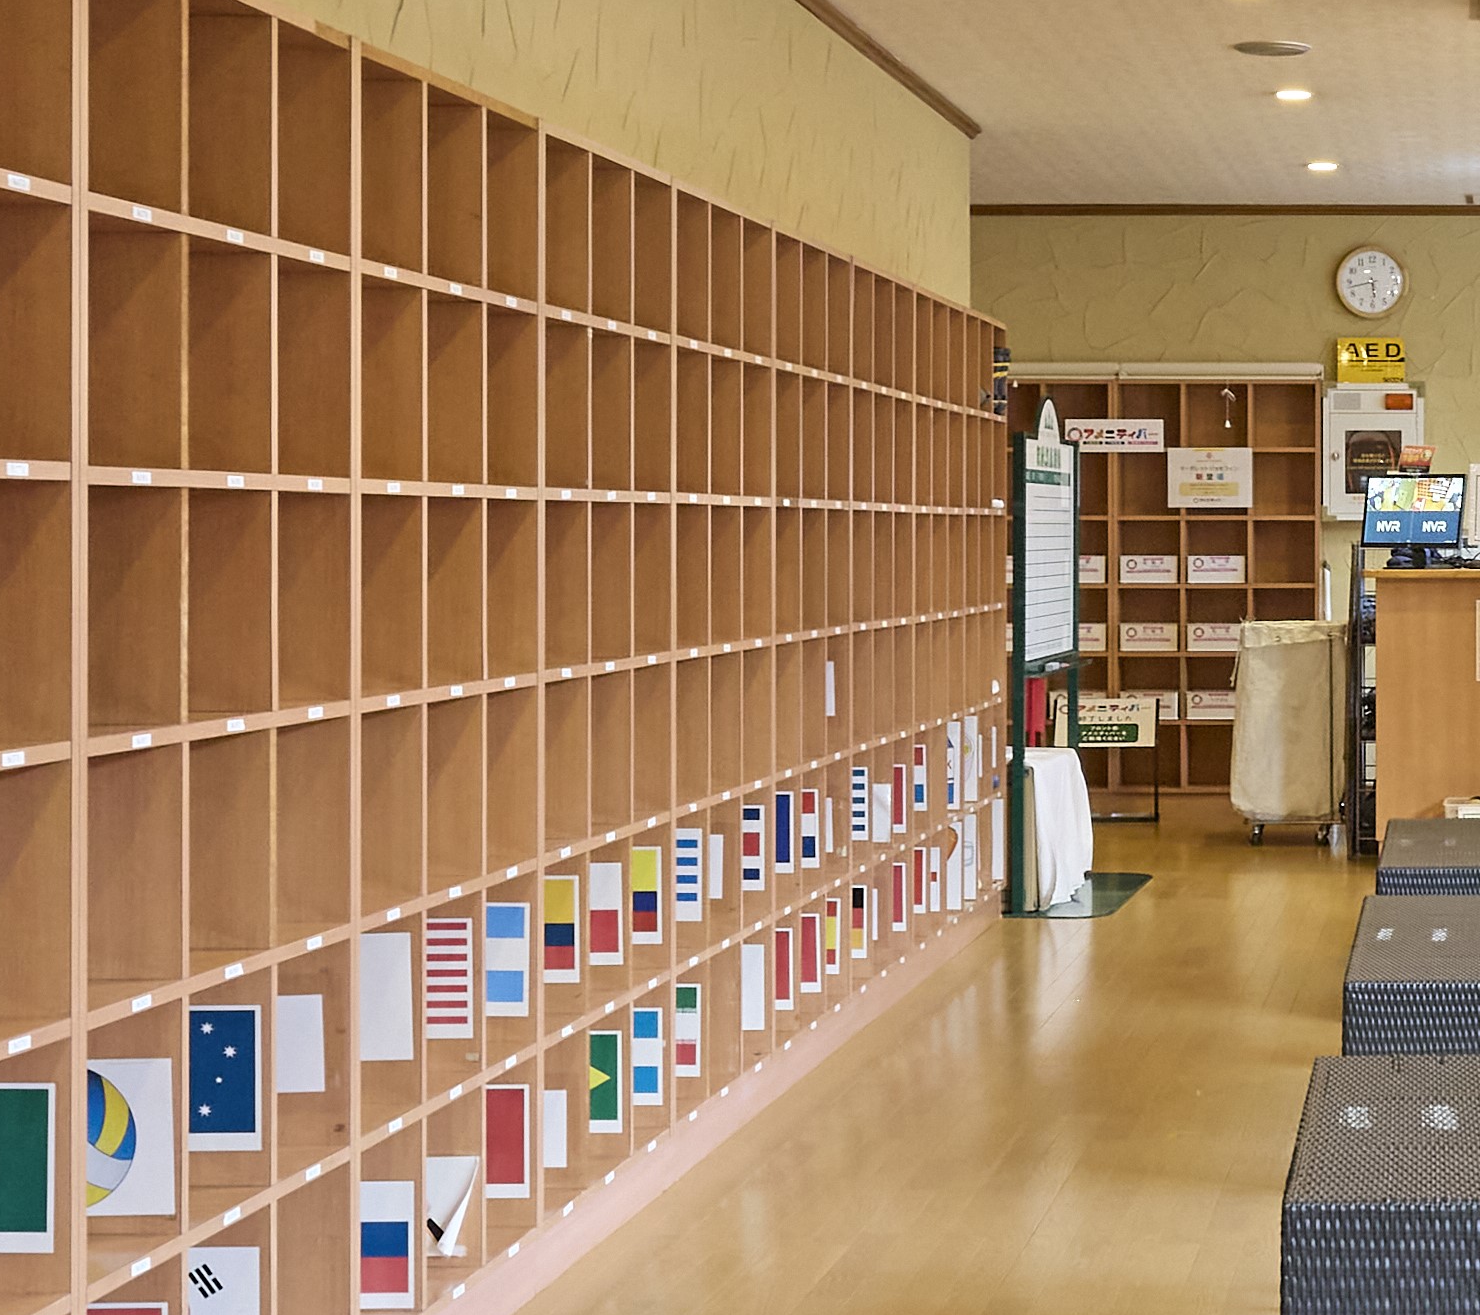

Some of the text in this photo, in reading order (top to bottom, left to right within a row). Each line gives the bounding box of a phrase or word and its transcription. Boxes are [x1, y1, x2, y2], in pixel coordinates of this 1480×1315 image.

[1345, 342, 1402, 358] AED
[1083, 428, 1159, 440] アメニティバー
[1376, 520, 1447, 533] NVR NVR
